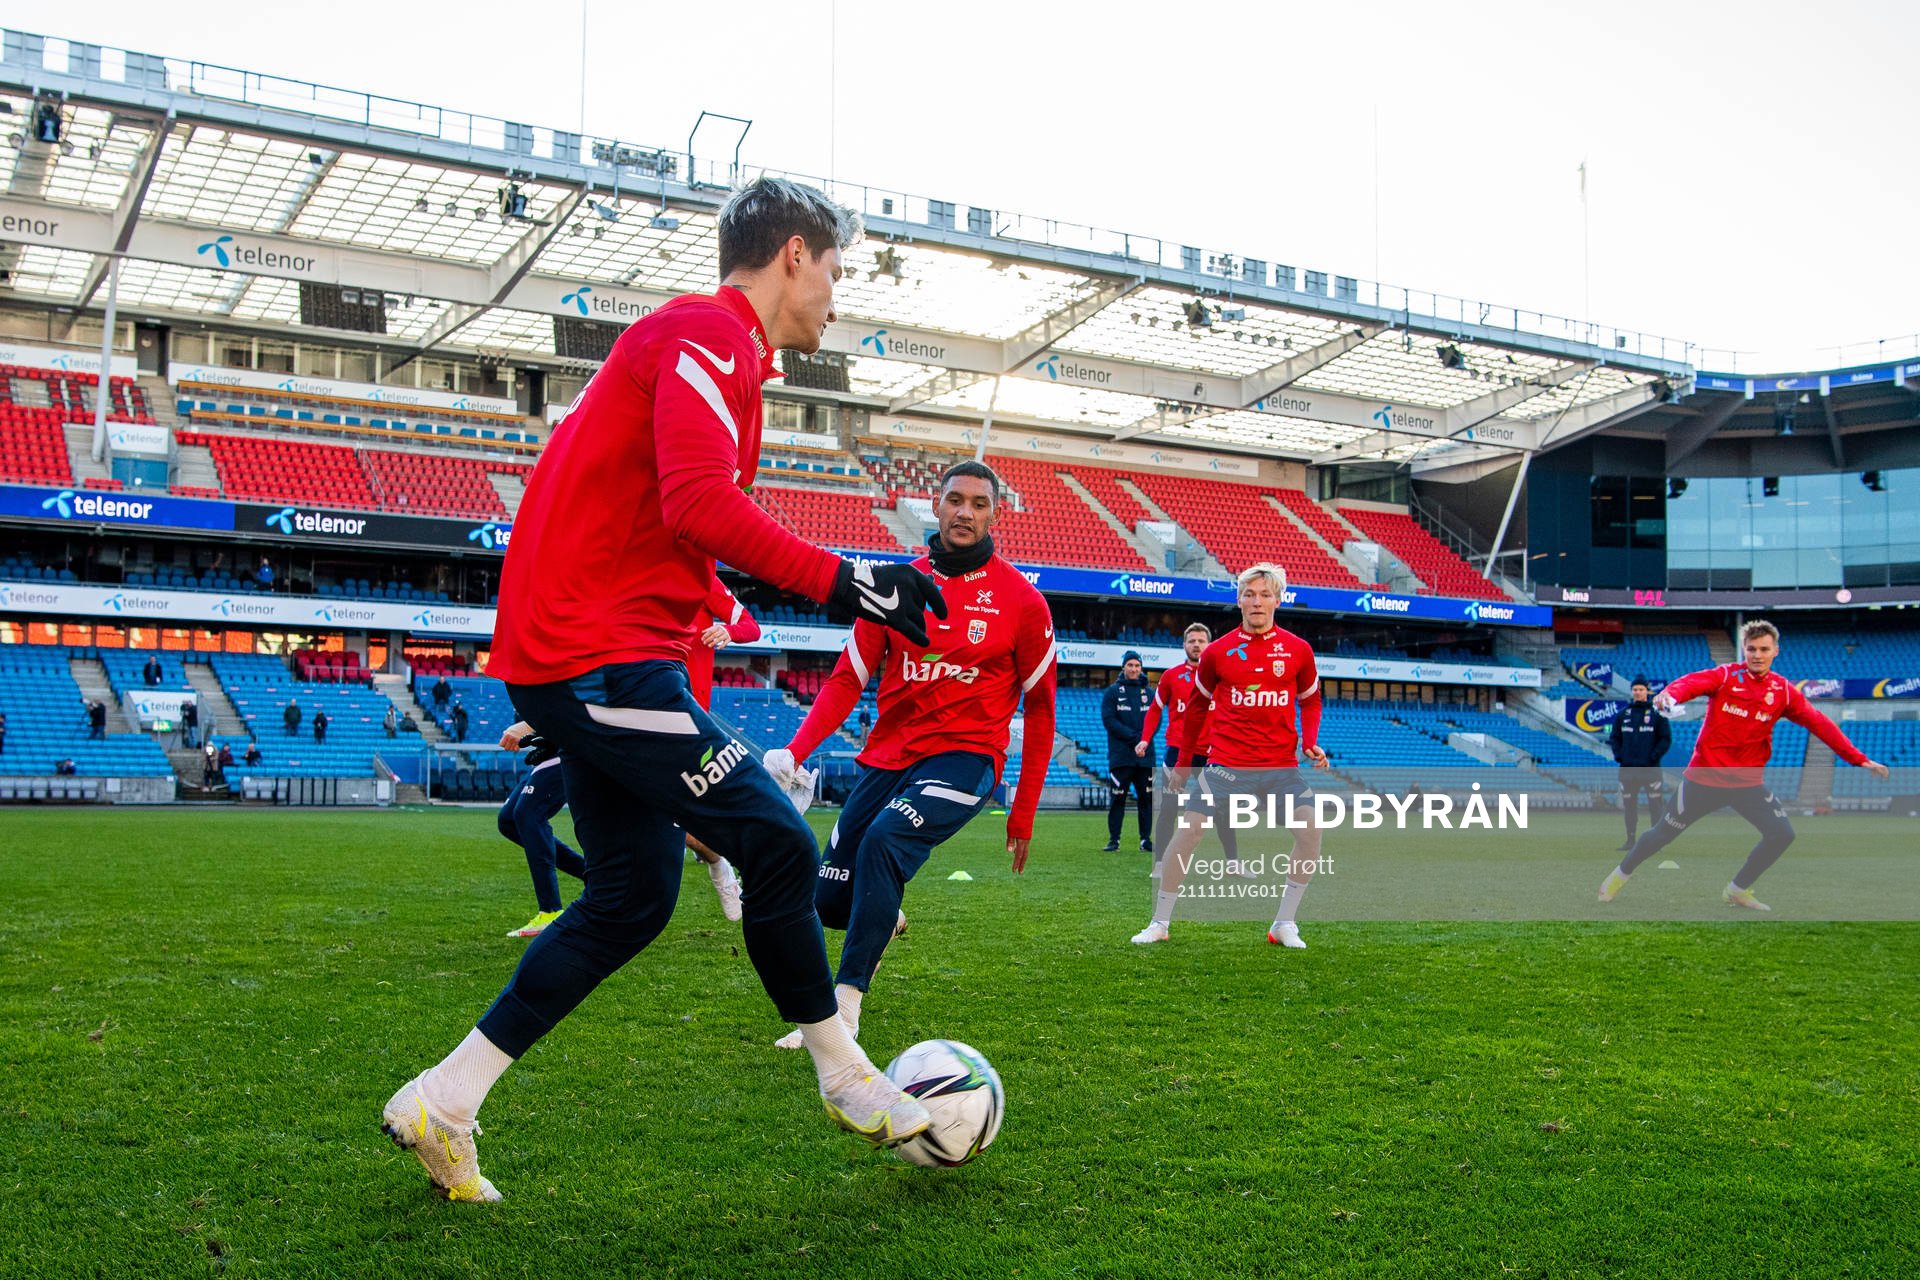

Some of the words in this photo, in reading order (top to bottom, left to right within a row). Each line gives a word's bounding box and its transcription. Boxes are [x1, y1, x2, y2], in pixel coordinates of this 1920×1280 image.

[235, 245, 316, 272] telenor
[749, 326, 767, 359] bama
[888, 338, 946, 360] telenor
[202, 373, 241, 386] telenor
[1060, 363, 1112, 384] telenor
[295, 383, 333, 394] telenor
[383, 392, 419, 404] telenor
[1266, 393, 1311, 413] telenor
[467, 401, 502, 413] telenor
[1393, 412, 1434, 430] telenor
[904, 423, 932, 434] telenor
[1475, 425, 1514, 441] telenor
[126, 431, 164, 443] telenor
[1037, 439, 1062, 450] telenor
[74, 496, 152, 519] telenor
[295, 512, 366, 535] telenor
[964, 571, 987, 582] bama
[1129, 577, 1174, 594] telenor
[10, 591, 58, 605] telenor
[1562, 589, 1589, 602] bama
[123, 597, 169, 610] telenor
[230, 602, 275, 615] telenor
[1371, 595, 1410, 612] telenor
[333, 607, 375, 621] telenor
[430, 613, 471, 625] telenor
[1478, 604, 1514, 620] telenor
[777, 632, 811, 643] telenor
[1067, 648, 1096, 658] telenor
[902, 651, 980, 684] bama
[1367, 665, 1390, 675] telenor
[1419, 667, 1442, 677] telenor
[1587, 664, 1611, 679] Bendit
[1470, 670, 1493, 680] telenor
[1516, 673, 1538, 682] telenor
[1231, 686, 1289, 707] bama
[1587, 702, 1619, 723] Bendit
[1722, 702, 1749, 717] bama
[680, 738, 748, 797] bama
[818, 864, 849, 881] ama
